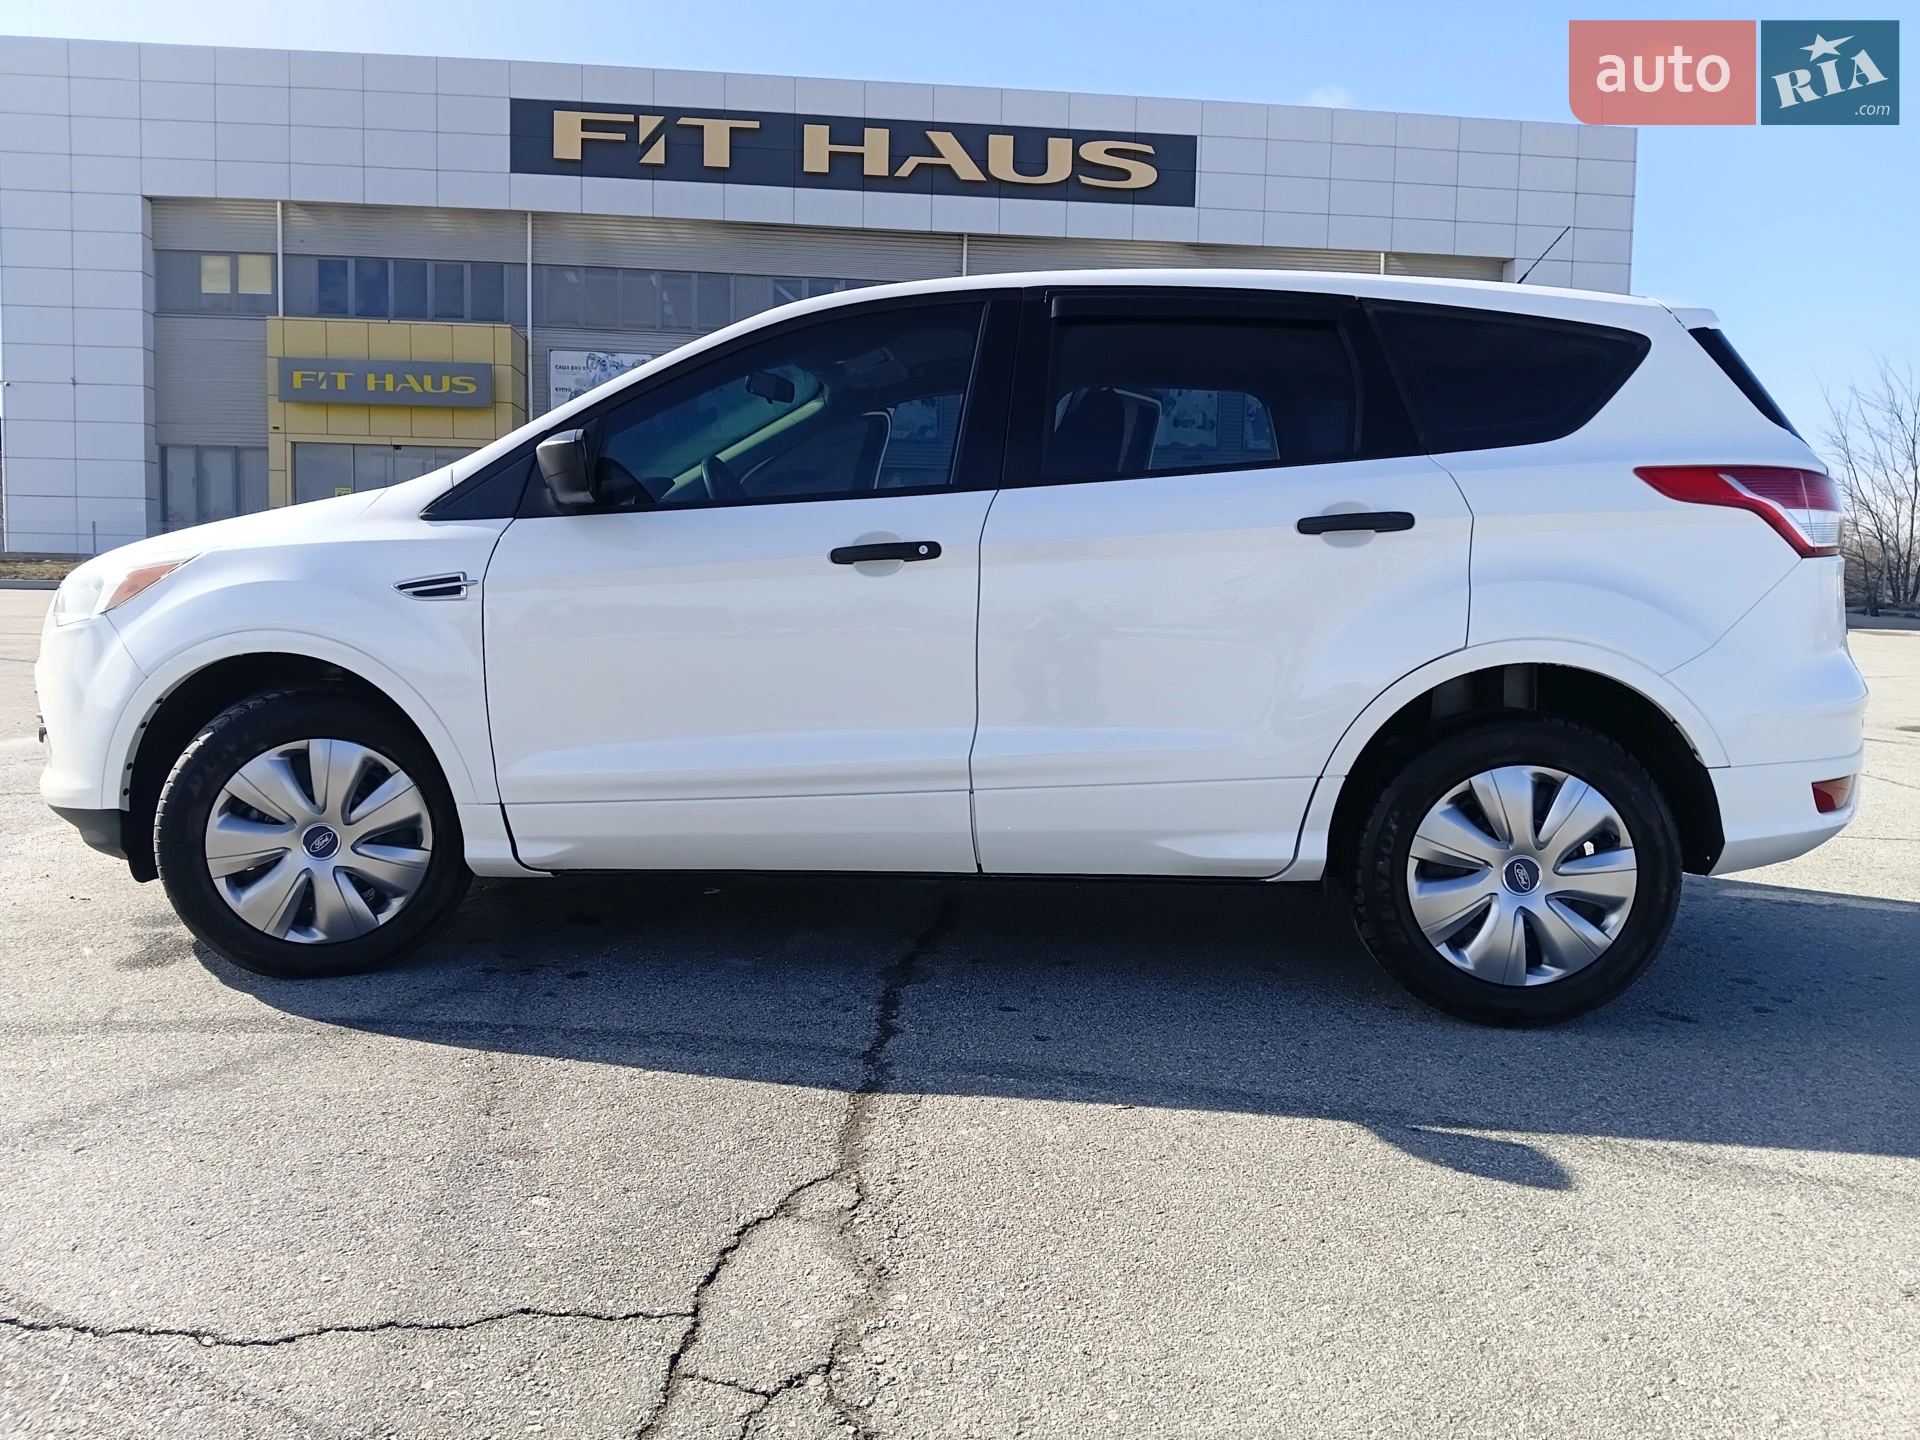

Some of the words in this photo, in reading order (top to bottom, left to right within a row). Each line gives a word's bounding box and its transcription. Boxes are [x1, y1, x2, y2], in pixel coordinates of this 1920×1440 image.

[553, 110, 760, 168] FIT
[803, 123, 1158, 190] HAUS
[292, 370, 355, 390] FIT
[366, 373, 477, 395] HAUS
